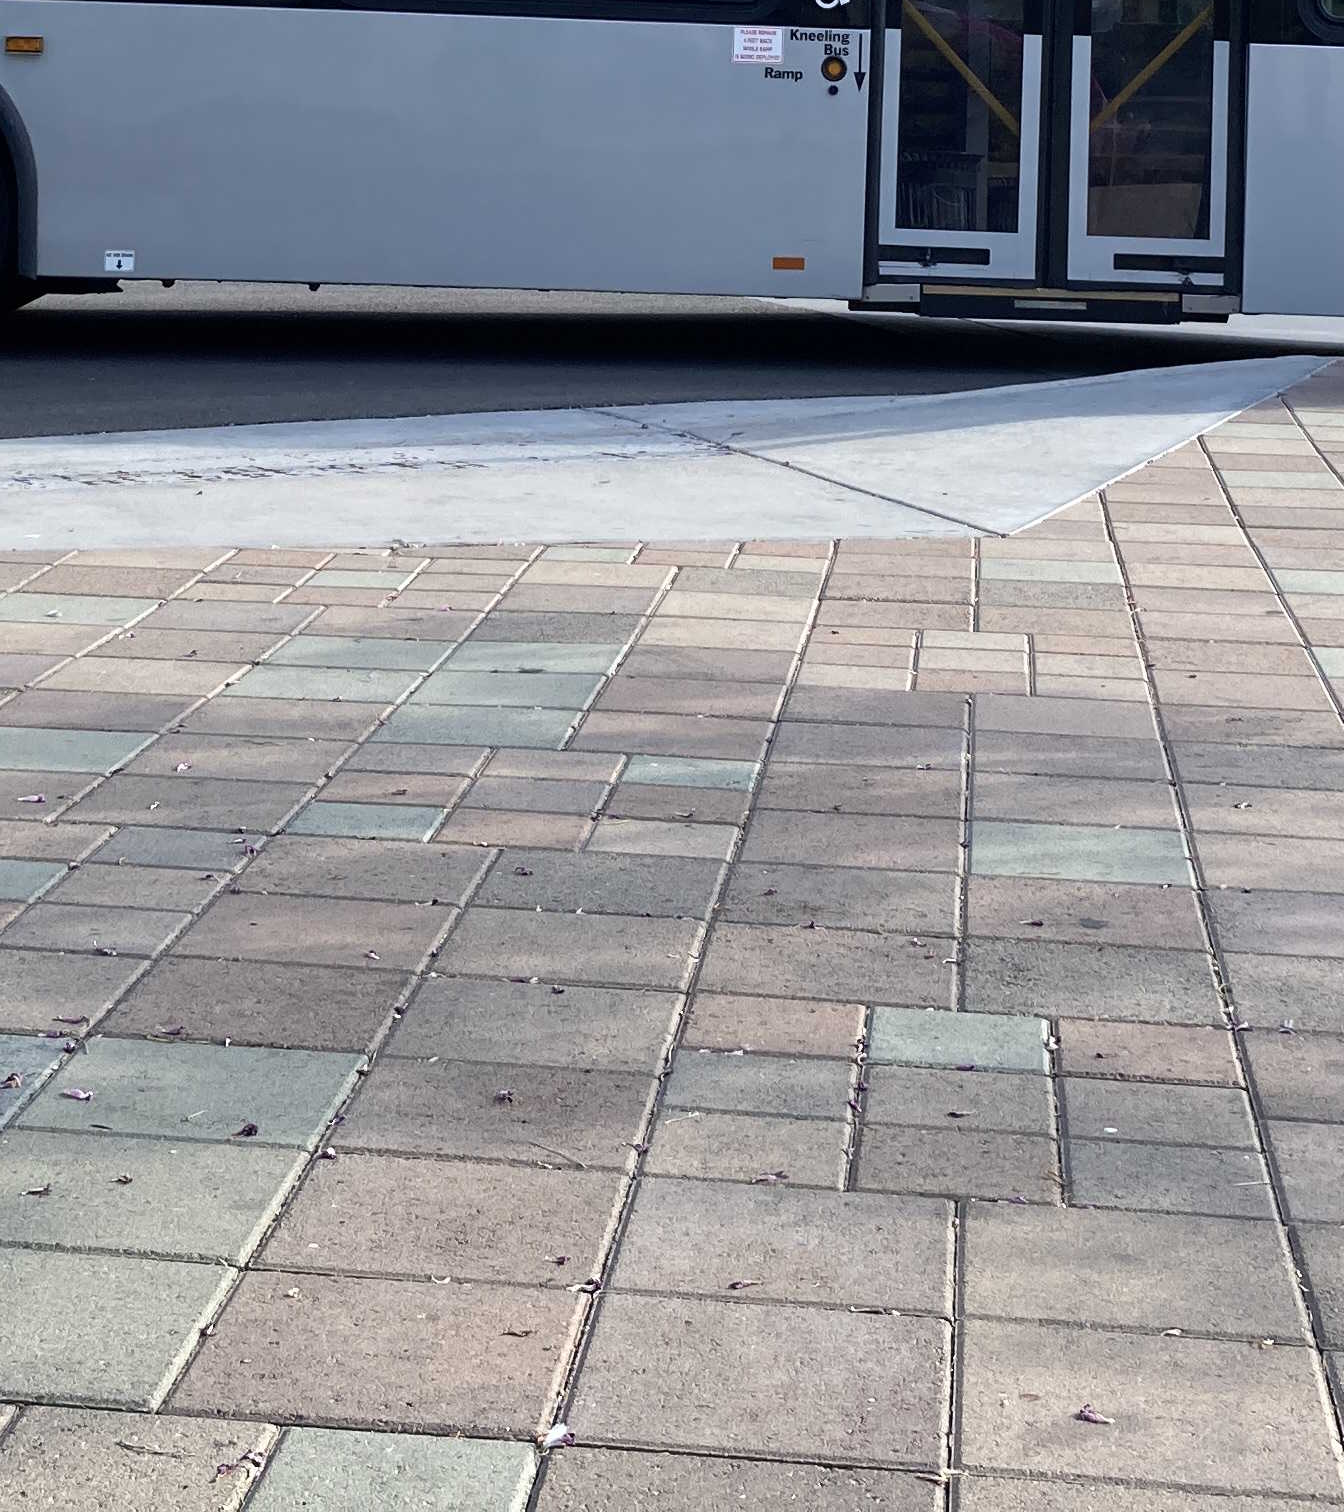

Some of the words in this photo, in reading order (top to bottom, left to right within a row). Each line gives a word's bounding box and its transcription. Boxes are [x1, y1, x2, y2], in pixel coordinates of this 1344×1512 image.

[790, 28, 851, 46] Kneeling
[823, 43, 849, 56] Bus
[764, 67, 803, 82] Ramp
